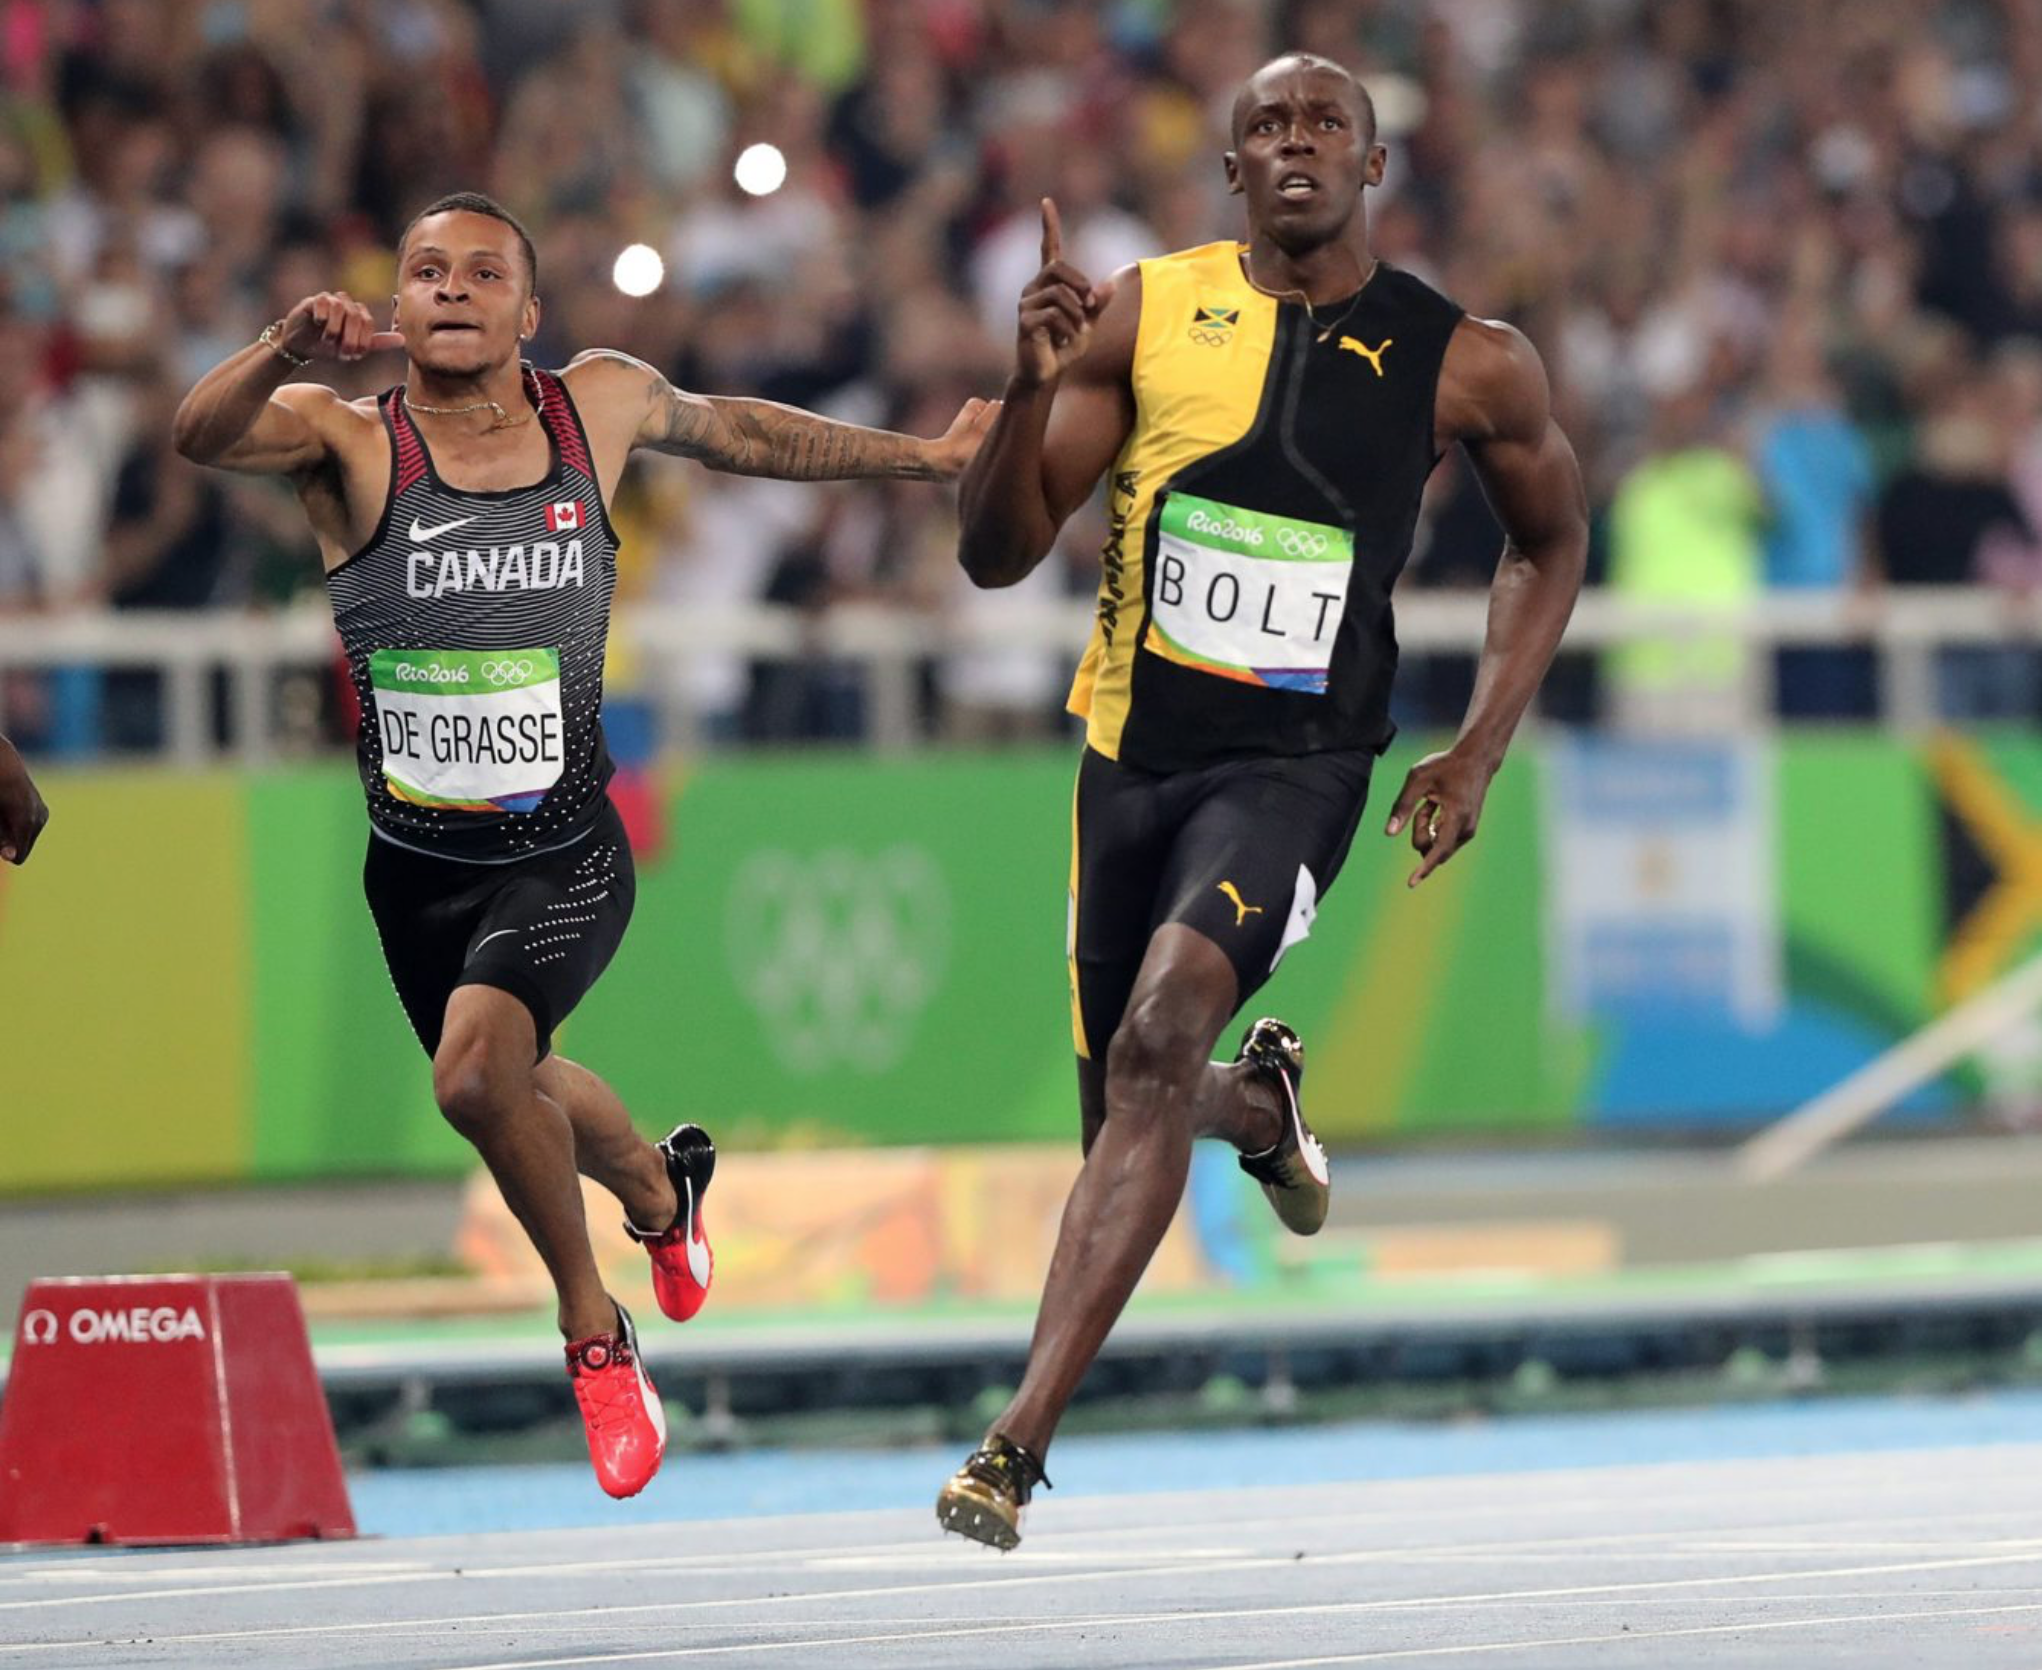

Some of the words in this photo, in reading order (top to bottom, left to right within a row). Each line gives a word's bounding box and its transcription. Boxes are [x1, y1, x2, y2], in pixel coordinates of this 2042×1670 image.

[406, 540, 584, 598] CANADA
[1159, 554, 1341, 642] BOLT
[382, 708, 420, 760] DE
[430, 713, 559, 764] GRASSE
[69, 1306, 205, 1344] OMEGA
